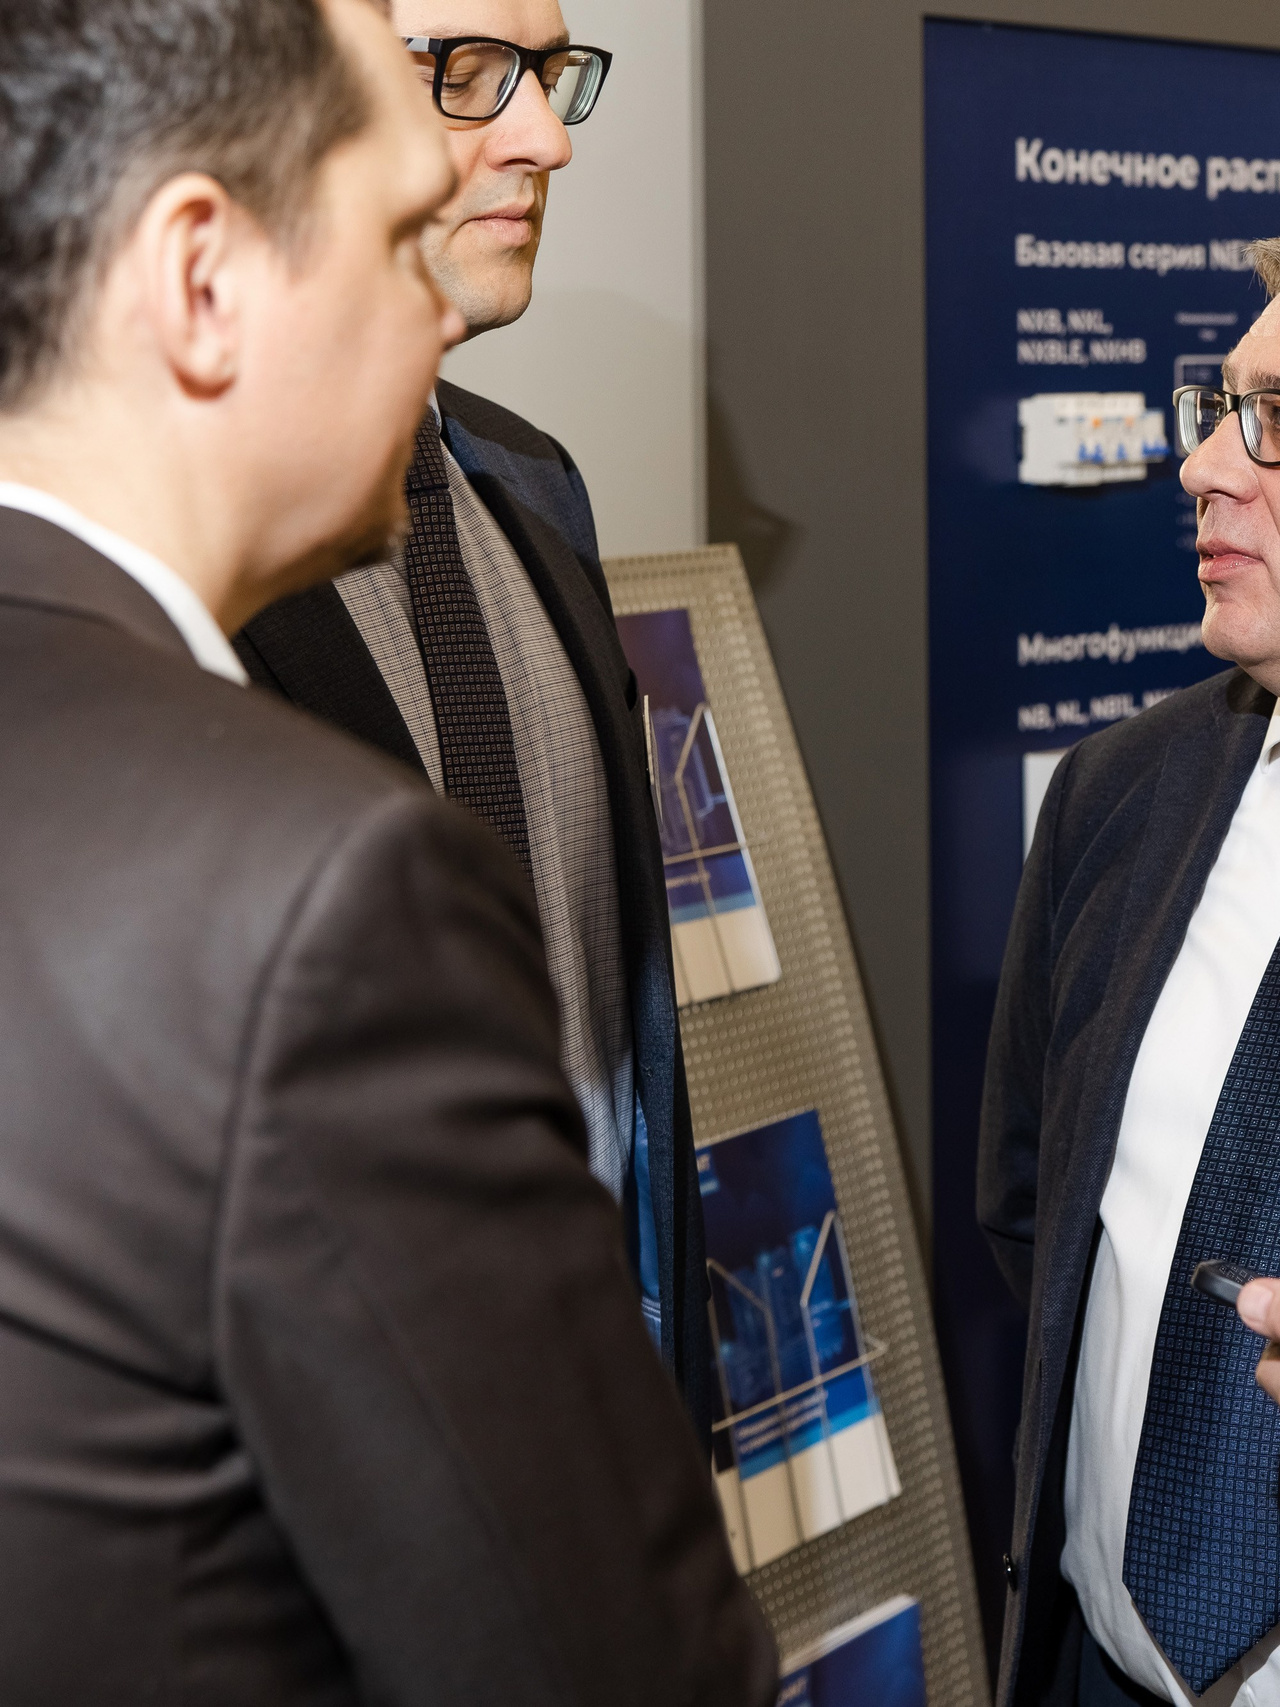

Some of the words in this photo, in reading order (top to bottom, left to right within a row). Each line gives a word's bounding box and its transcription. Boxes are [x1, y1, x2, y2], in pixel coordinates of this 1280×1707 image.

[1015, 136, 1199, 191] Конечное
[1015, 233, 1125, 269] Базовая
[1127, 241, 1206, 277] серия
